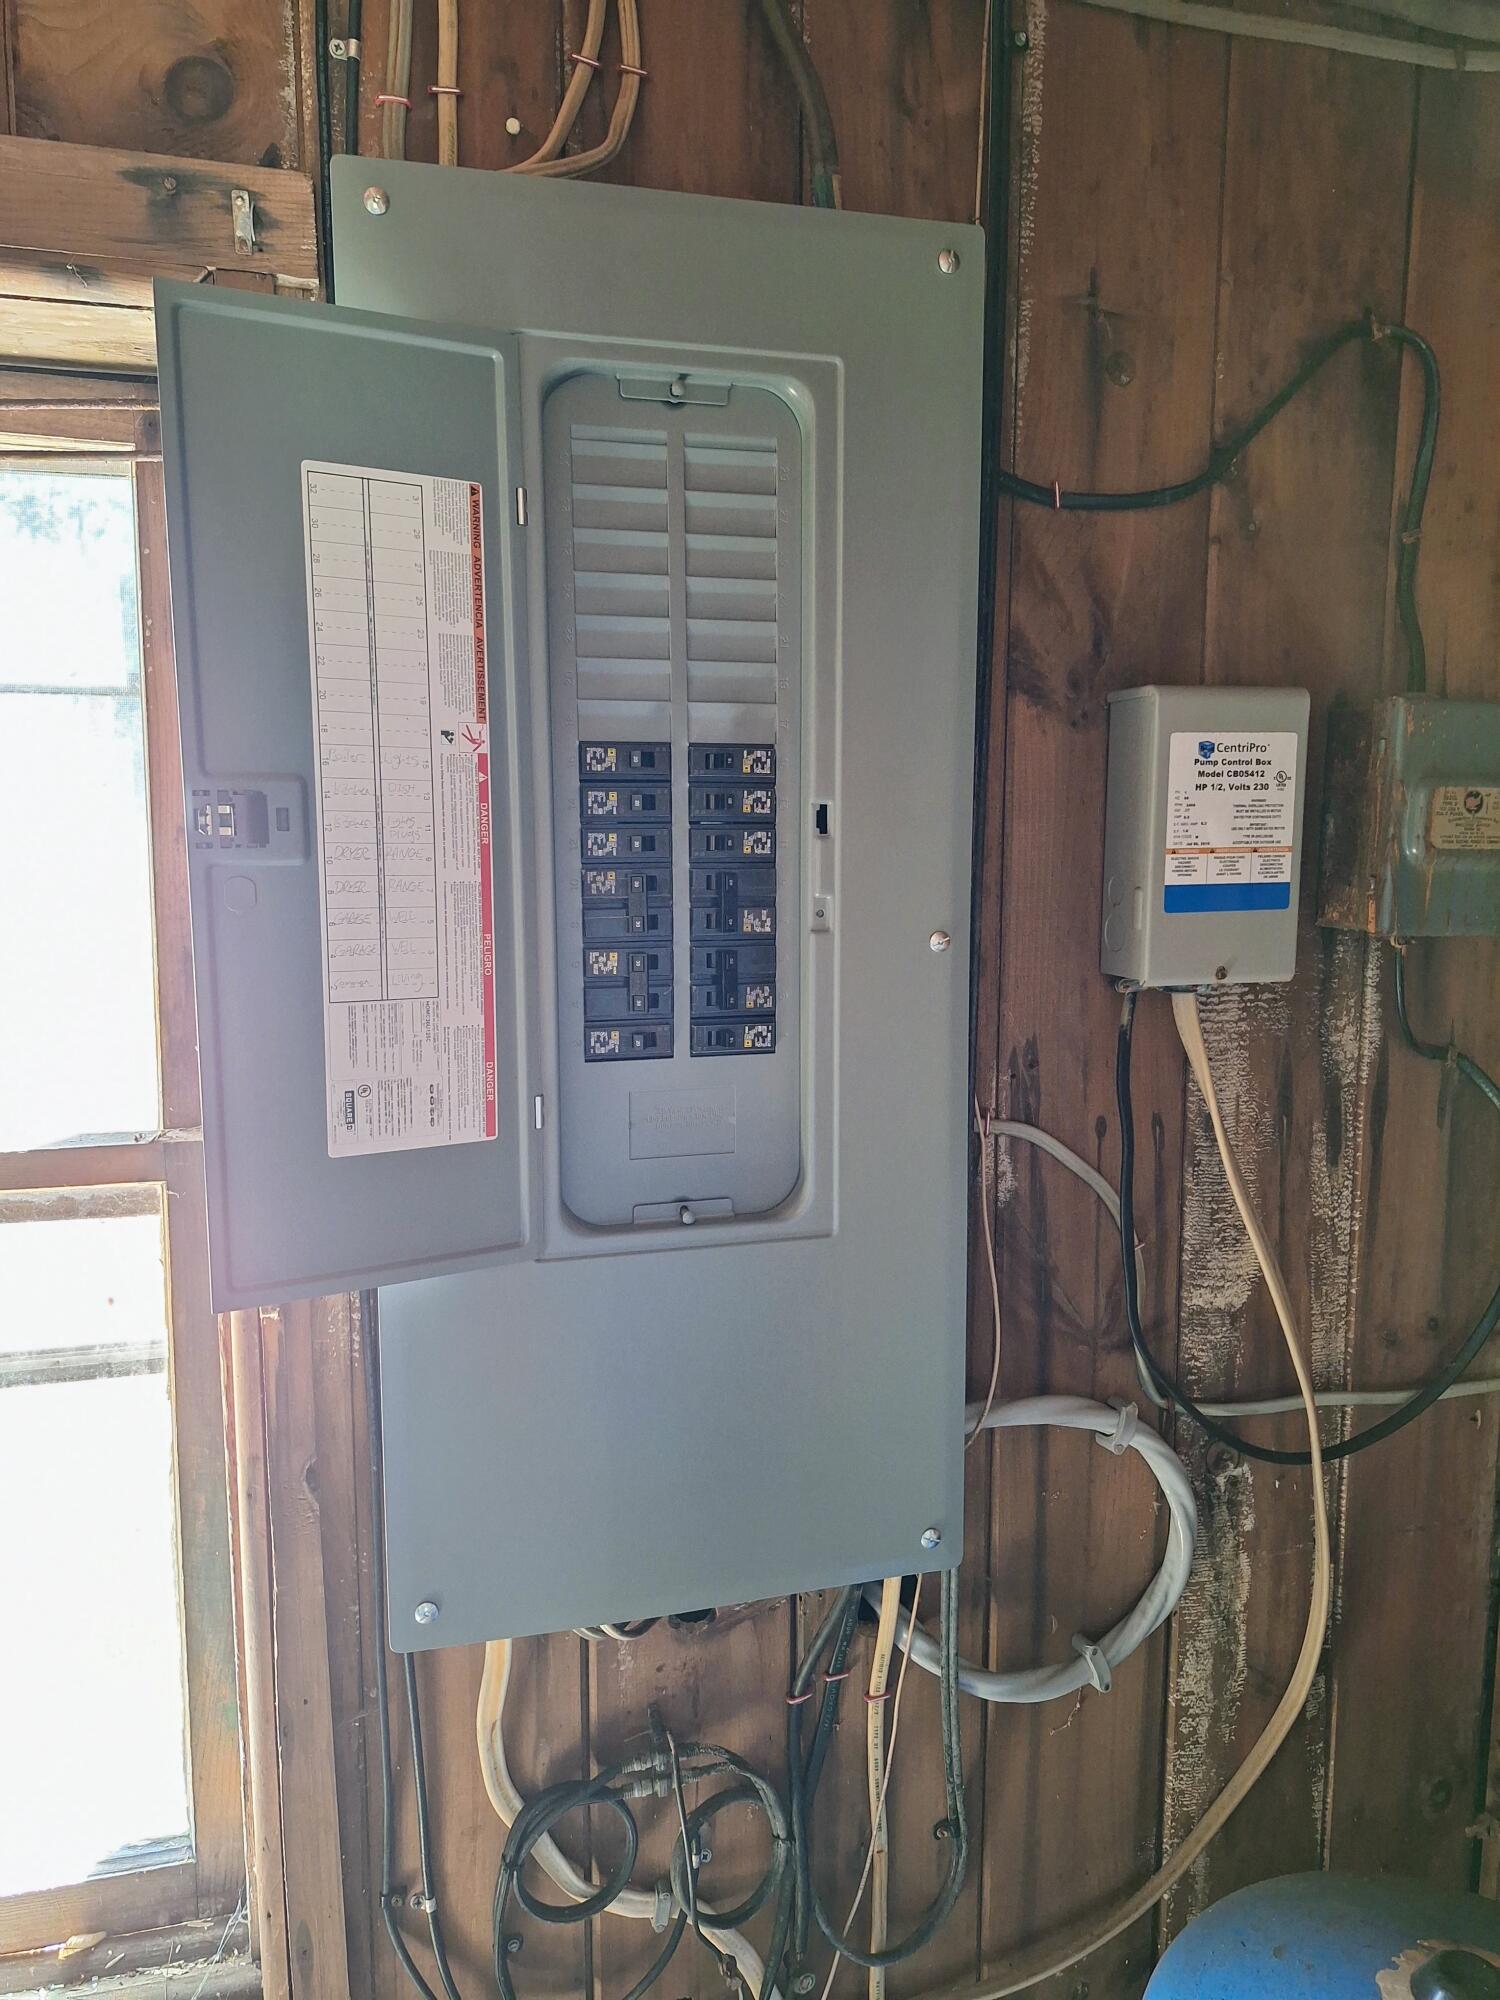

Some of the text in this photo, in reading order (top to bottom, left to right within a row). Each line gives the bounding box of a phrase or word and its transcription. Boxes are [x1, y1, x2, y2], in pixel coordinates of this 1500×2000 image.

[310, 484, 317, 494] 32
[412, 496, 419, 504] 31
[312, 518, 319, 528] 30
[414, 529, 420, 539] 29
[313, 553, 320, 563] 28
[315, 588, 322, 598] 26
[416, 596, 423, 606] 25
[472, 498, 486, 720] WARNING ADVERTENCIA AVERTISSEMENT
[316, 622, 323, 632] 24
[417, 629, 424, 640] 23
[318, 656, 325, 666] 22
[320, 690, 326, 700] 20
[321, 725, 328, 733] 18
[1216, 742, 1268, 753] CentriPro
[322, 758, 329, 766] 16
[422, 760, 429, 769] 15
[1211, 784, 1226, 792] 1/2,
[324, 790, 331, 799] 14
[325, 824, 333, 832] 12
[386, 847, 424, 859] RANGE
[326, 856, 333, 864] 10
[389, 880, 424, 892] RANGE
[392, 941, 416, 953] WELL
[483, 933, 492, 976] PELIGRO
